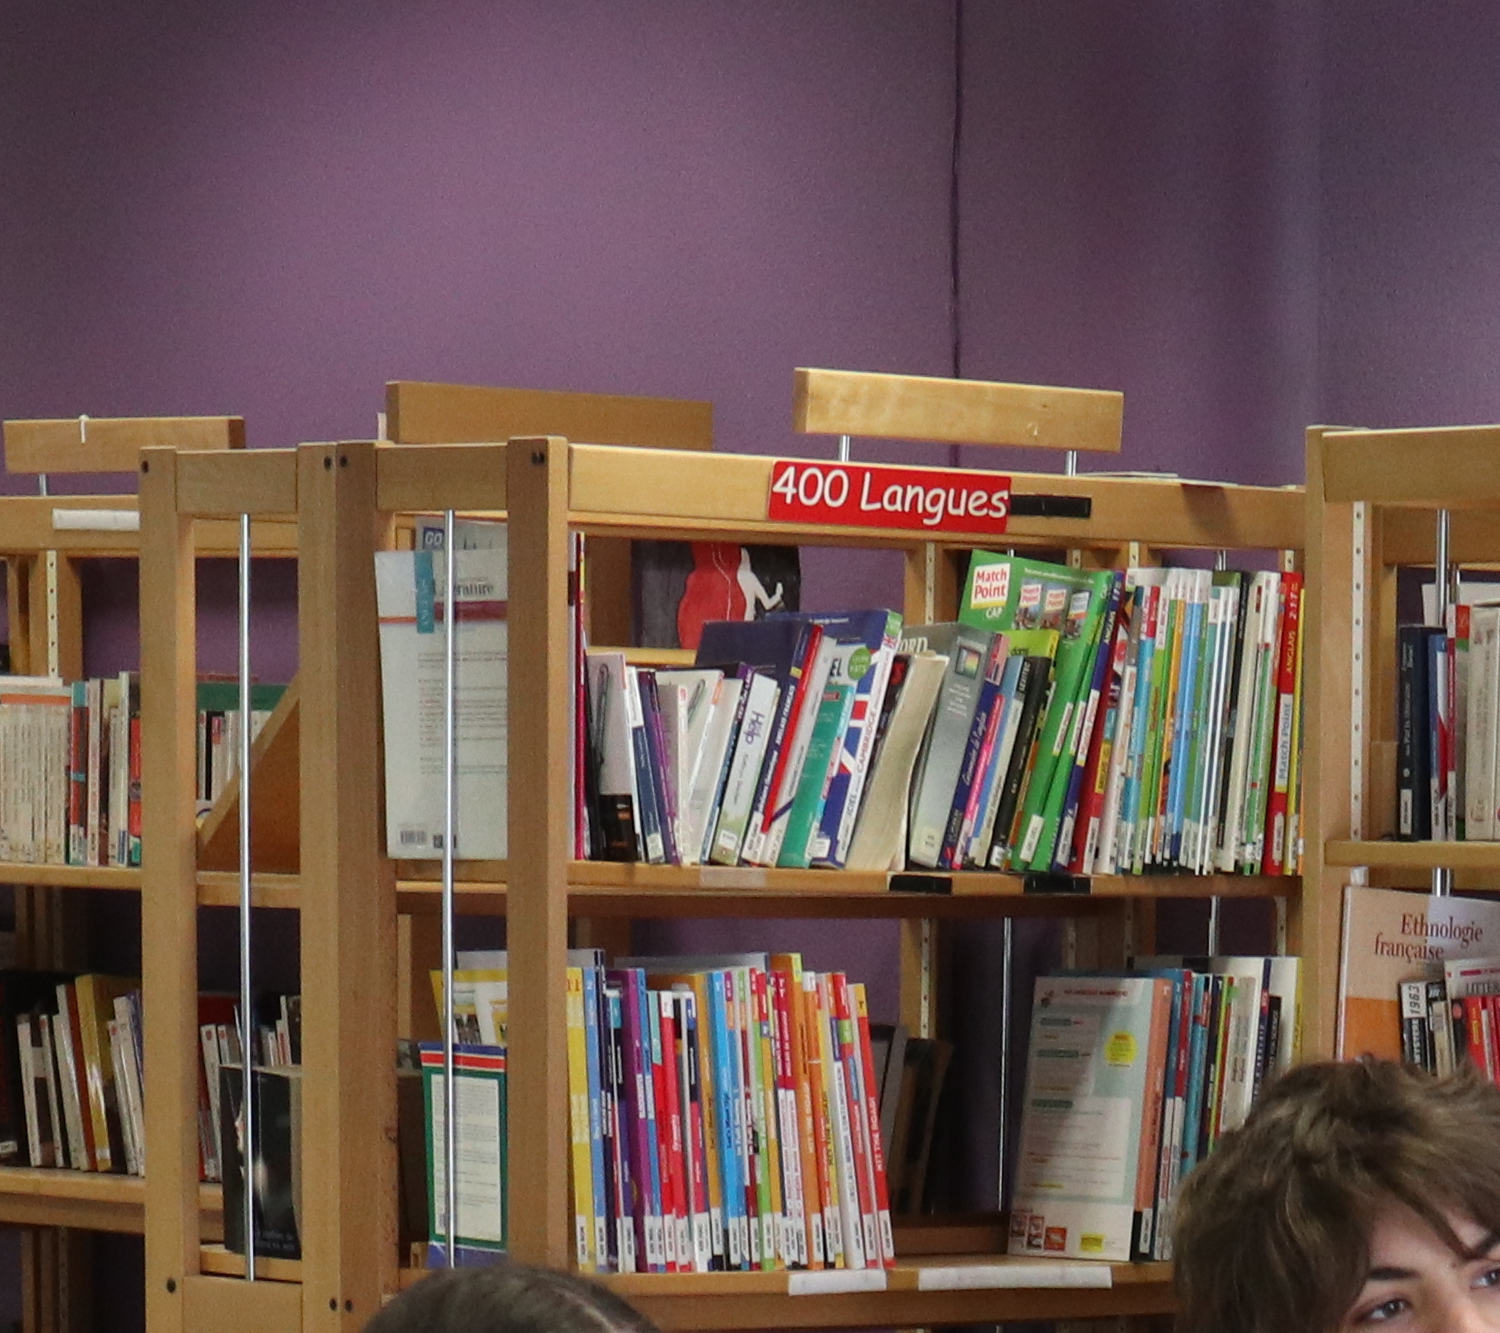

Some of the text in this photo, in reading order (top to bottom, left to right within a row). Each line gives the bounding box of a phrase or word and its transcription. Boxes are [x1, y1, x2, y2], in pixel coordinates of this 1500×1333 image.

[772, 465, 1010, 526] 400 Langues
[973, 567, 1008, 600] Match Point
[985, 606, 1004, 620] CAP
[855, 706, 878, 776] CAMBRIDGE
[1278, 702, 1293, 781] Match Point
[1374, 933, 1445, 963] française
[1400, 912, 1484, 950] Ethnologie
[1408, 985, 1422, 1016] 1963
